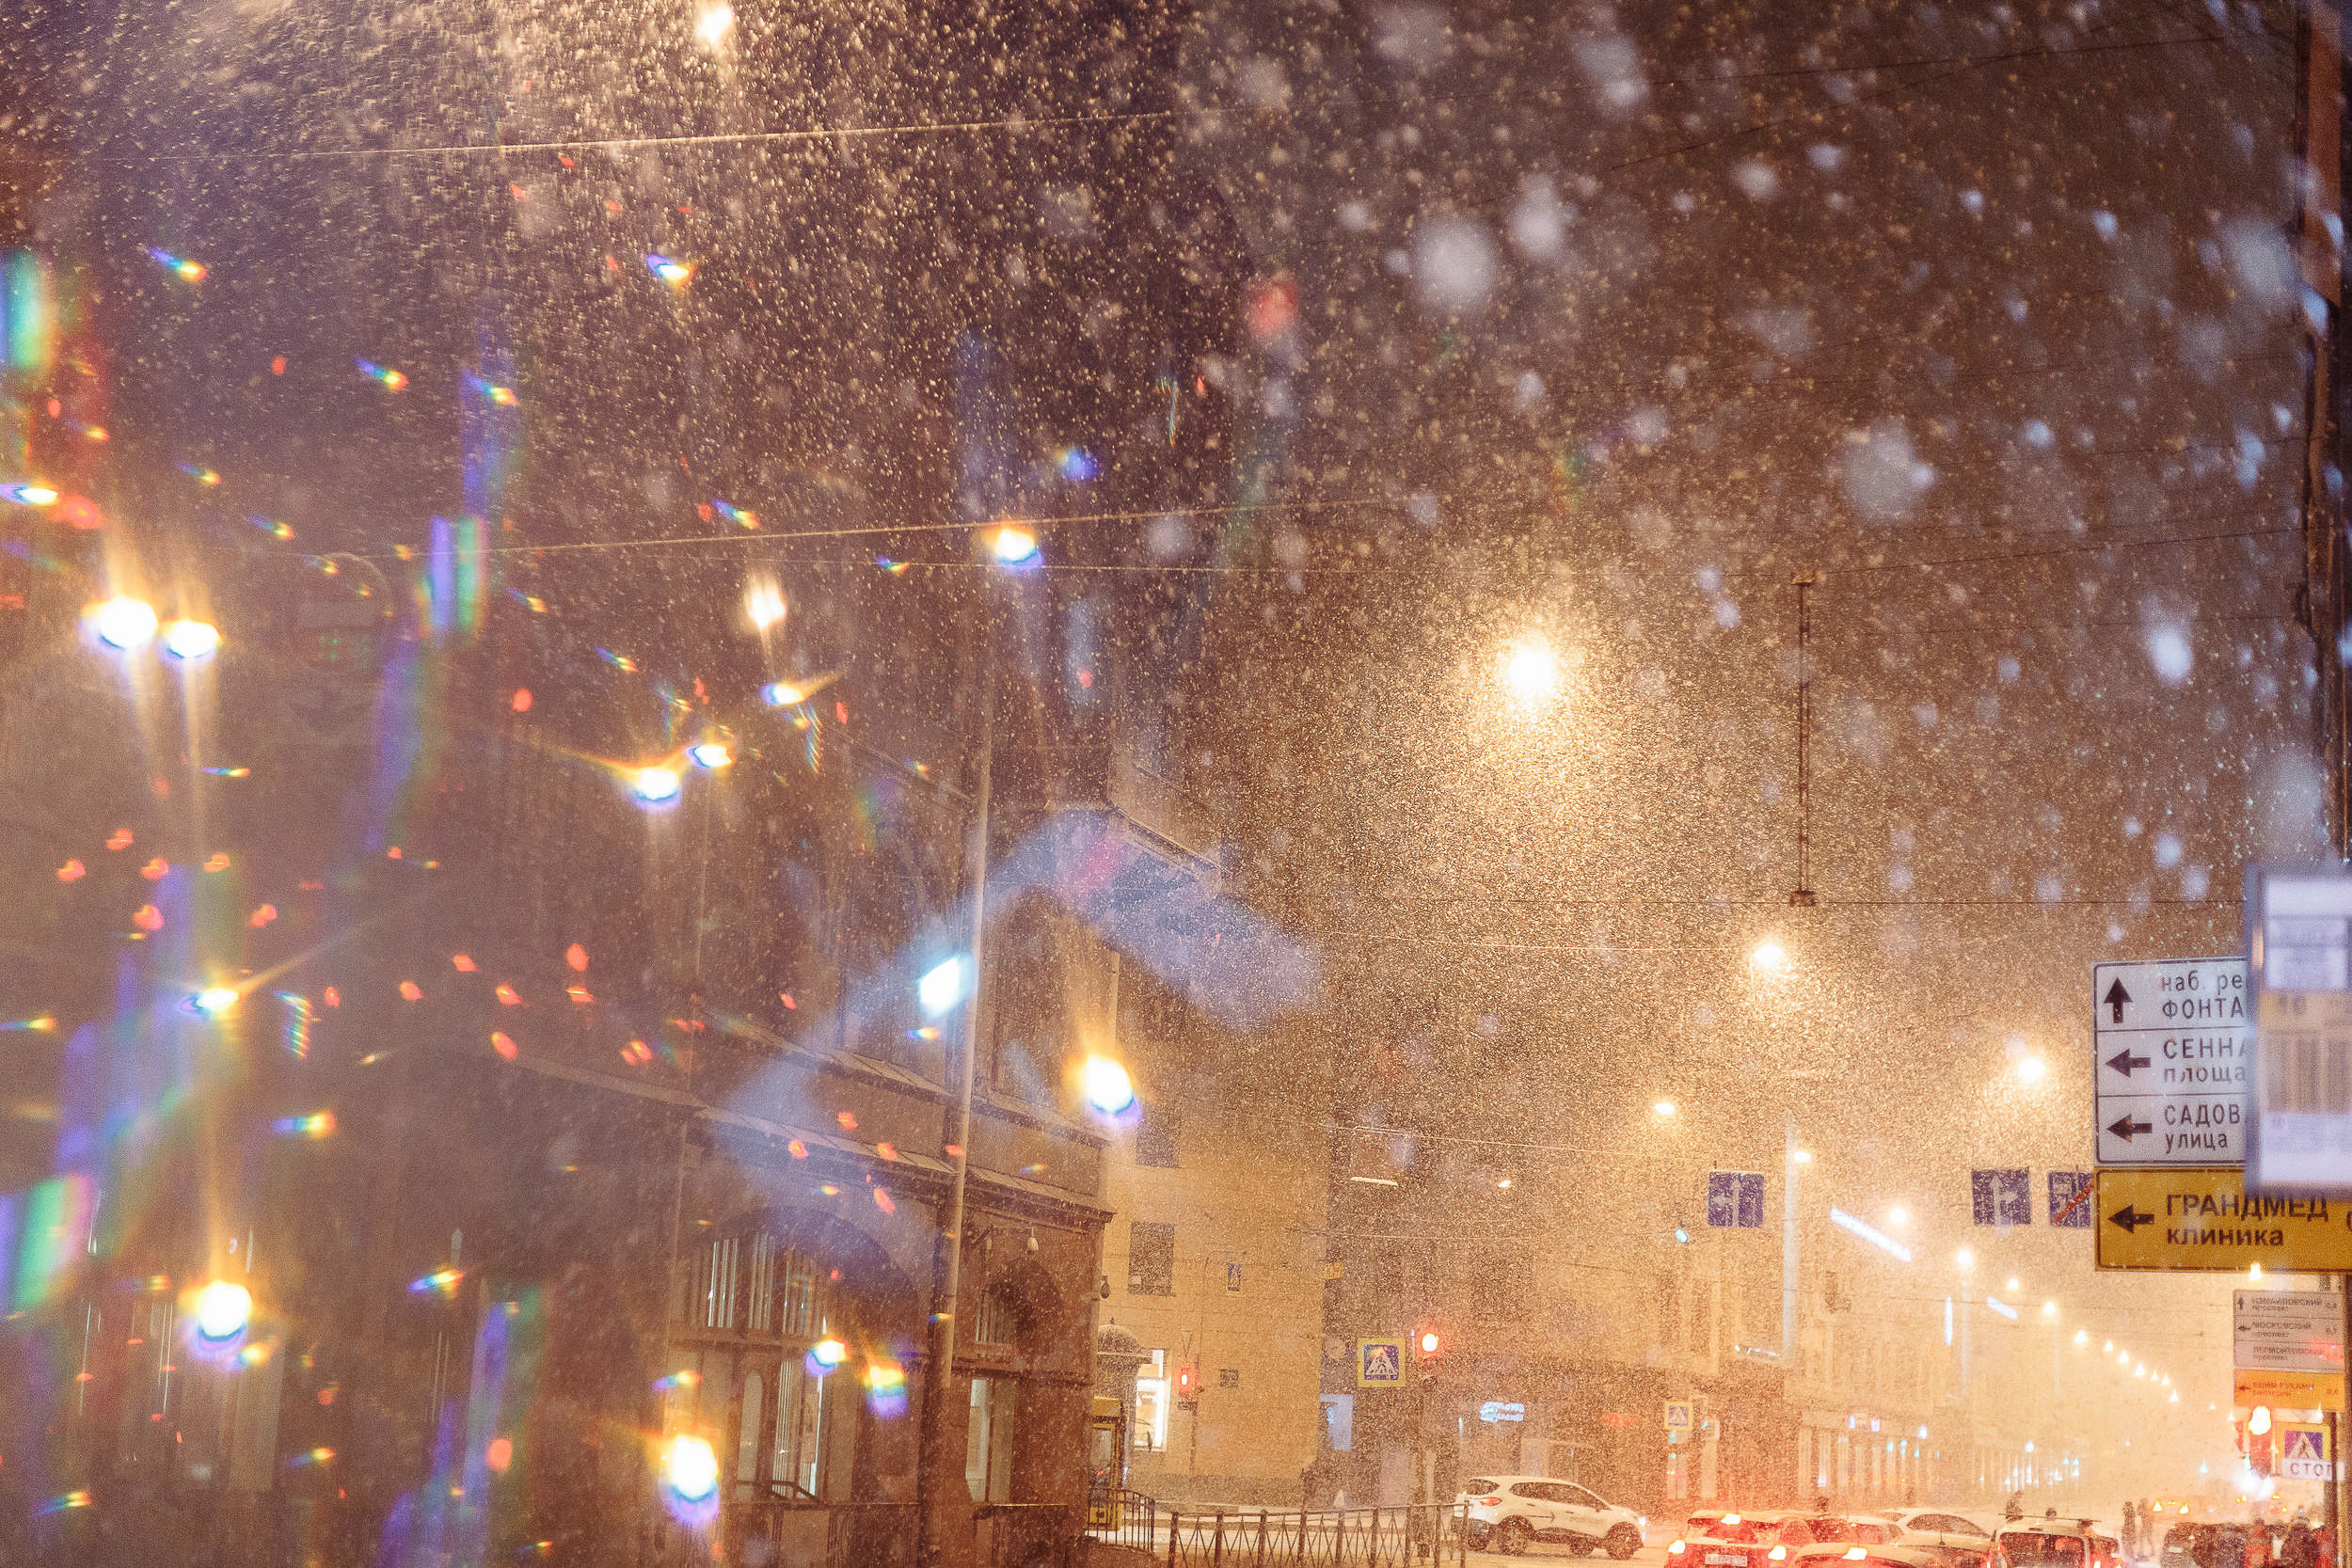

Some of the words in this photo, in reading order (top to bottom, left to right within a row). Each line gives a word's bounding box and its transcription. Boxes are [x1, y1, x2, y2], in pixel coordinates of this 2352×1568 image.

[2164, 1103, 2241, 1128] САДОВ
[2166, 1132, 2229, 1154] улица
[2167, 1194, 2328, 1223] ГРАНДМЕД
[2167, 1227, 2284, 1246] клиника
